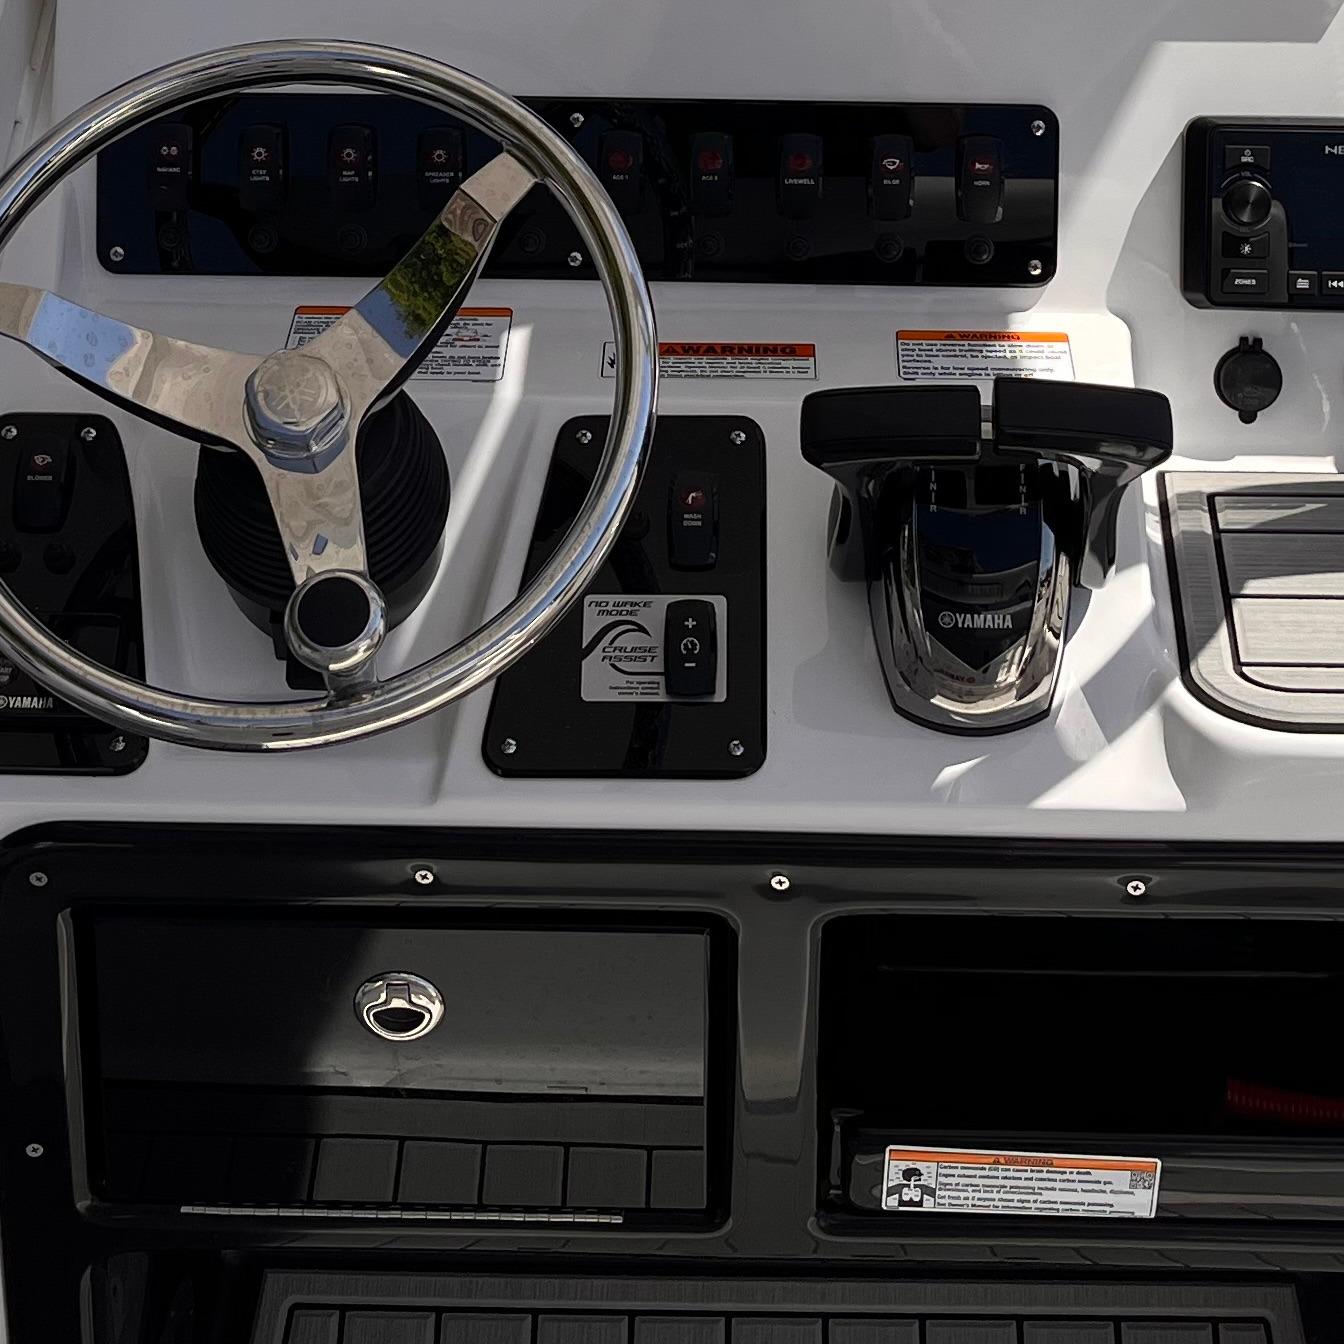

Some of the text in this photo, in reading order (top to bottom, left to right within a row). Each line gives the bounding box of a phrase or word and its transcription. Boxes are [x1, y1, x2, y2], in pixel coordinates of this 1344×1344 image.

[958, 333, 1020, 341] WARNING
[680, 345, 797, 355] WARNING
[587, 600, 653, 608] NO WAKE
[596, 609, 640, 617] MODE
[957, 613, 1013, 629] YAMAHA
[601, 645, 659, 654] CRUISE
[601, 655, 659, 663] ASSIST
[8, 696, 54, 709] YAMAHA
[1003, 1156, 1054, 1166] WARNING
